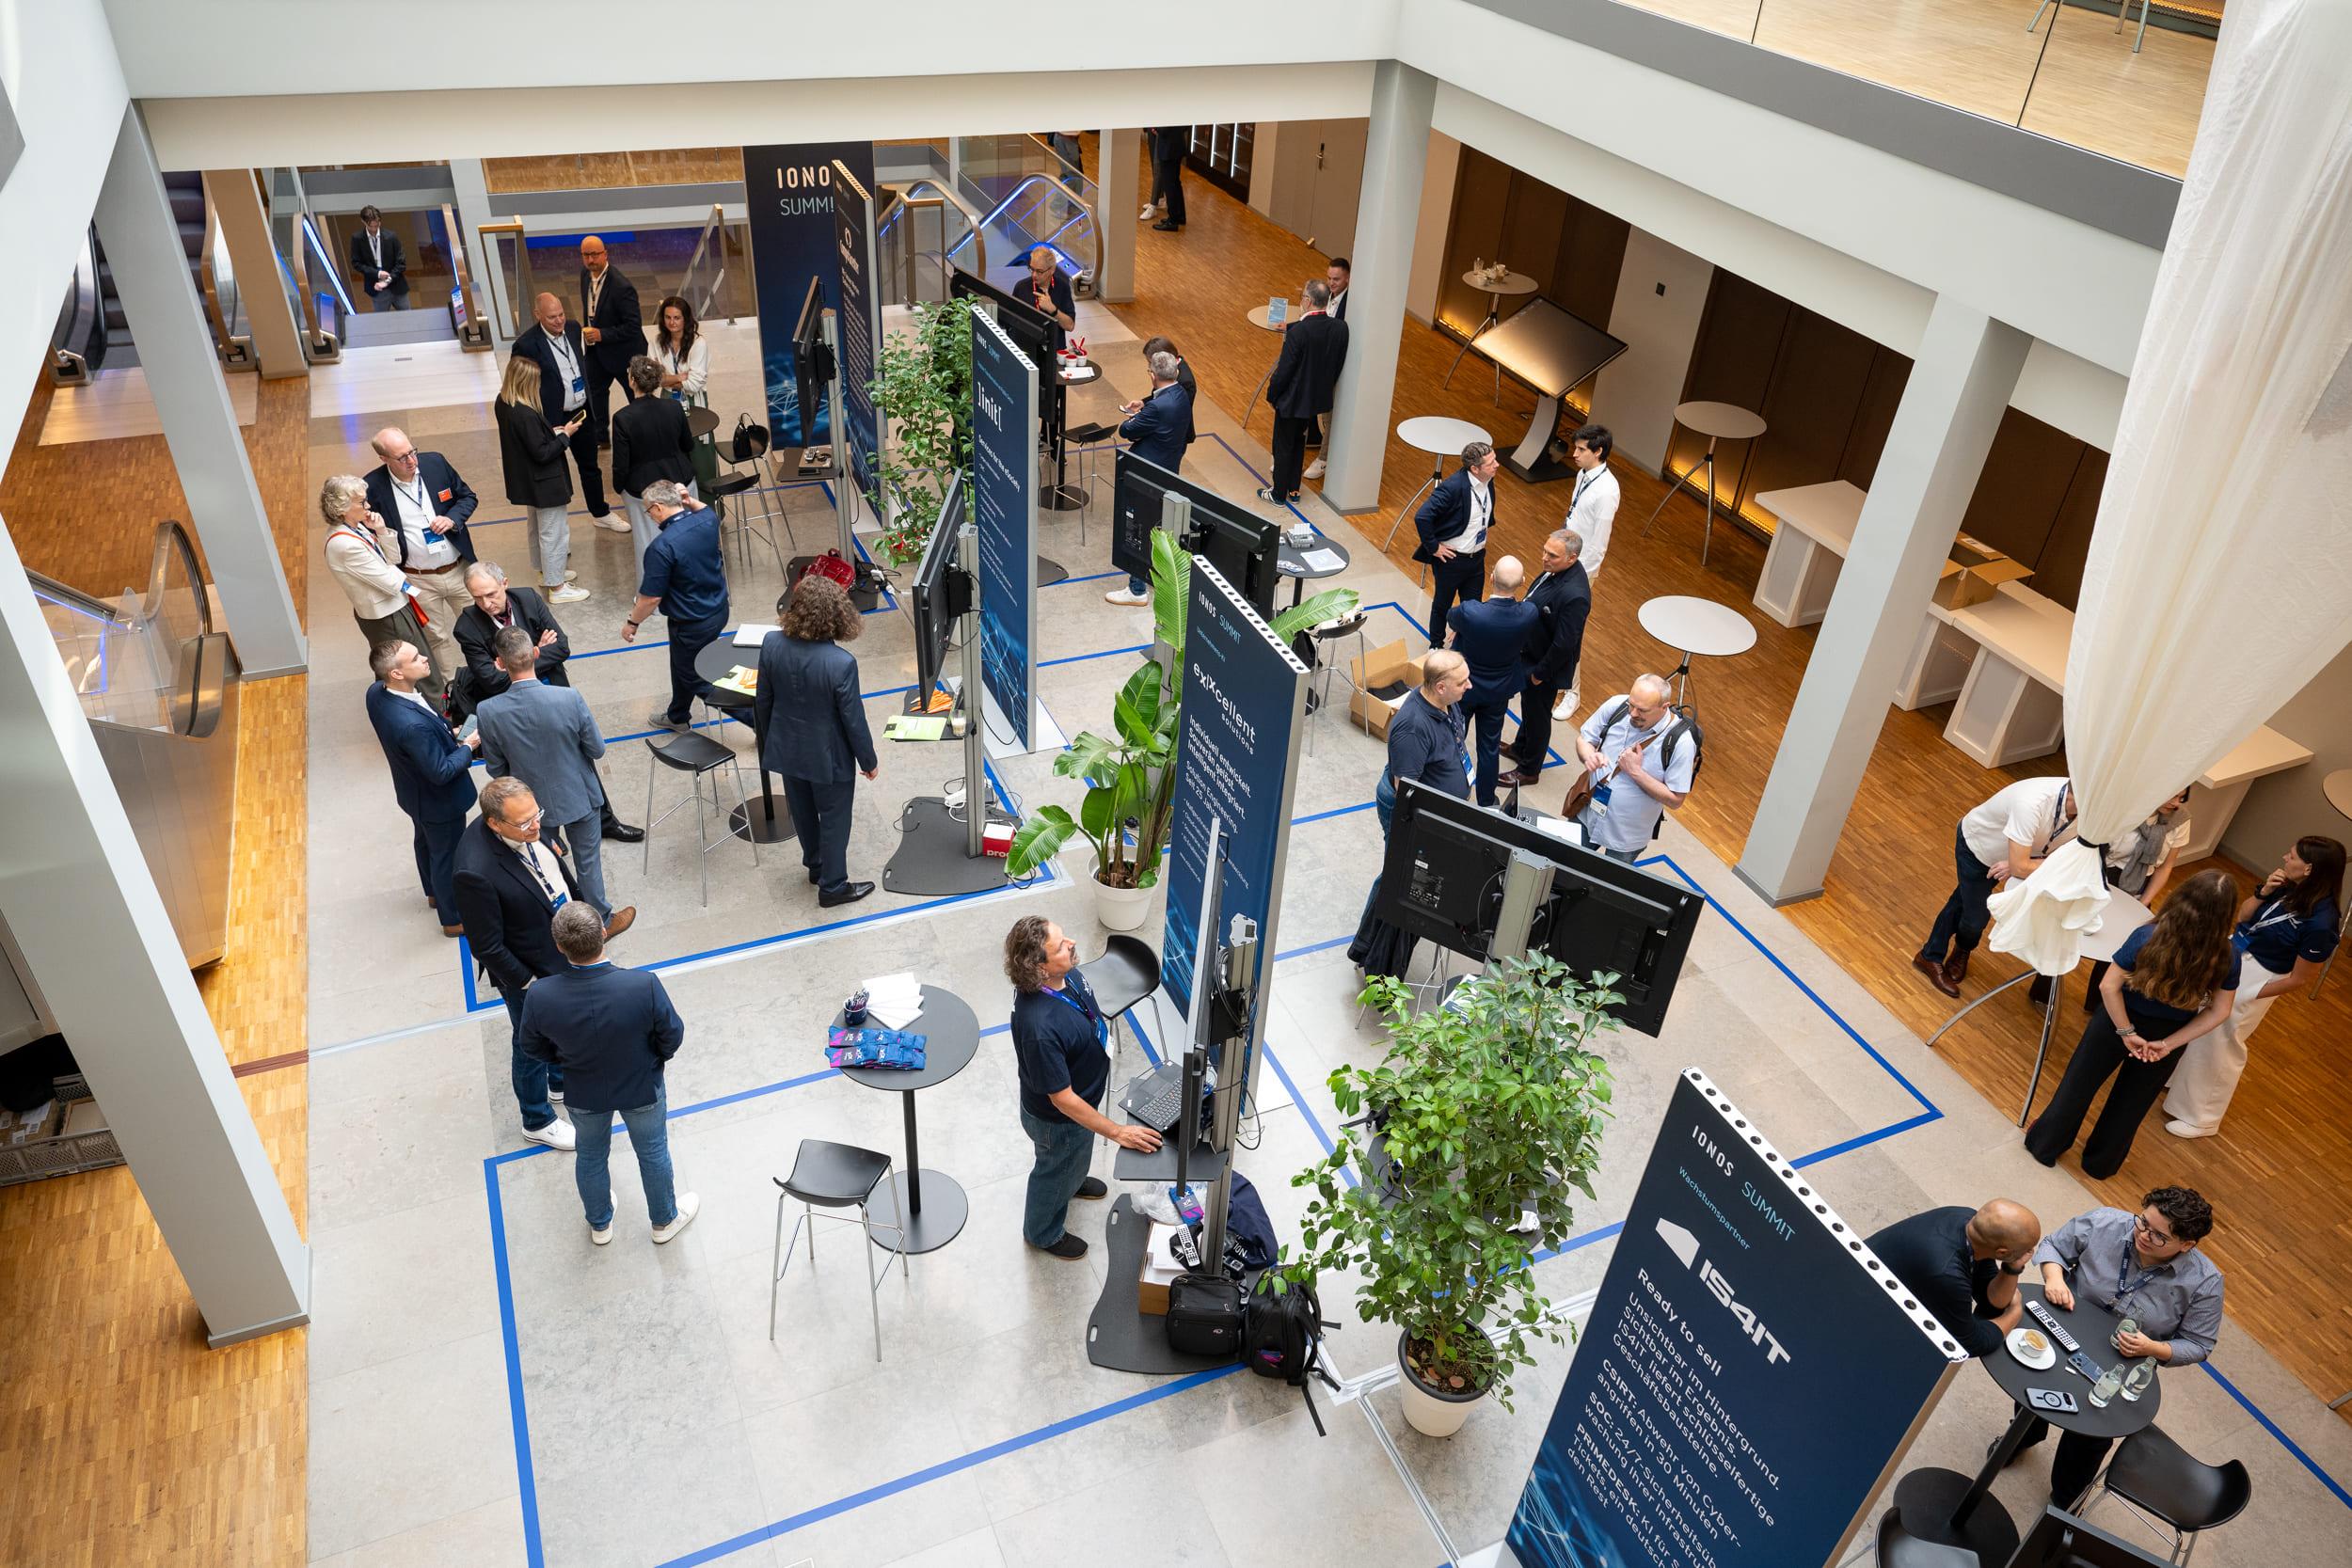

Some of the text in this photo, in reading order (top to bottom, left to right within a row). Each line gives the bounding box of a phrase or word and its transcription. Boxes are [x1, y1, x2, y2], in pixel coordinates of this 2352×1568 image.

[777, 166, 830, 189] IONO
[1199, 591, 1216, 617] IONOS
[1185, 772, 1195, 789] Seit
[1195, 785, 1203, 800] 25
[1186, 760, 1206, 792] Solution
[1187, 739, 1216, 782] Intelligent
[1216, 777, 1246, 820] integriert.
[1189, 715, 1251, 798] Individuell entwickelt.
[1189, 728, 1235, 792] Souverän gelöst.
[1221, 713, 1254, 754] solutions
[1692, 1125, 1734, 1177] IONOS
[1678, 1166, 1750, 1250] Wachstumspartner
[1638, 1268, 1722, 1377] Ready to sell
[1699, 1259, 1791, 1365] IS4IT
[1613, 1334, 1720, 1479] Geschäftsbausteine.
[1618, 1319, 1774, 1528] IS4IT liefert schlüsselfertige
[1623, 1307, 1739, 1459] Sichtbar im Ergebnis.
[1629, 1291, 1780, 1491] Unsichtbar im Hintergrund.
[1567, 1447, 1609, 1511] den Rest
[1572, 1434, 1665, 1568] Tickets, ein deutsch
[1576, 1422, 1671, 1558] PRIMEDESK: KI für
[1584, 1404, 1705, 1568] wachung Ihrer Infrastru
[1588, 1391, 1716, 1568] SOC: 24/7-Sicherheitsüb
[1597, 1373, 1719, 1540] angriffen in 30 Minuten
[1602, 1358, 1741, 1548] CSIRT: Abwehr von Cyber-
